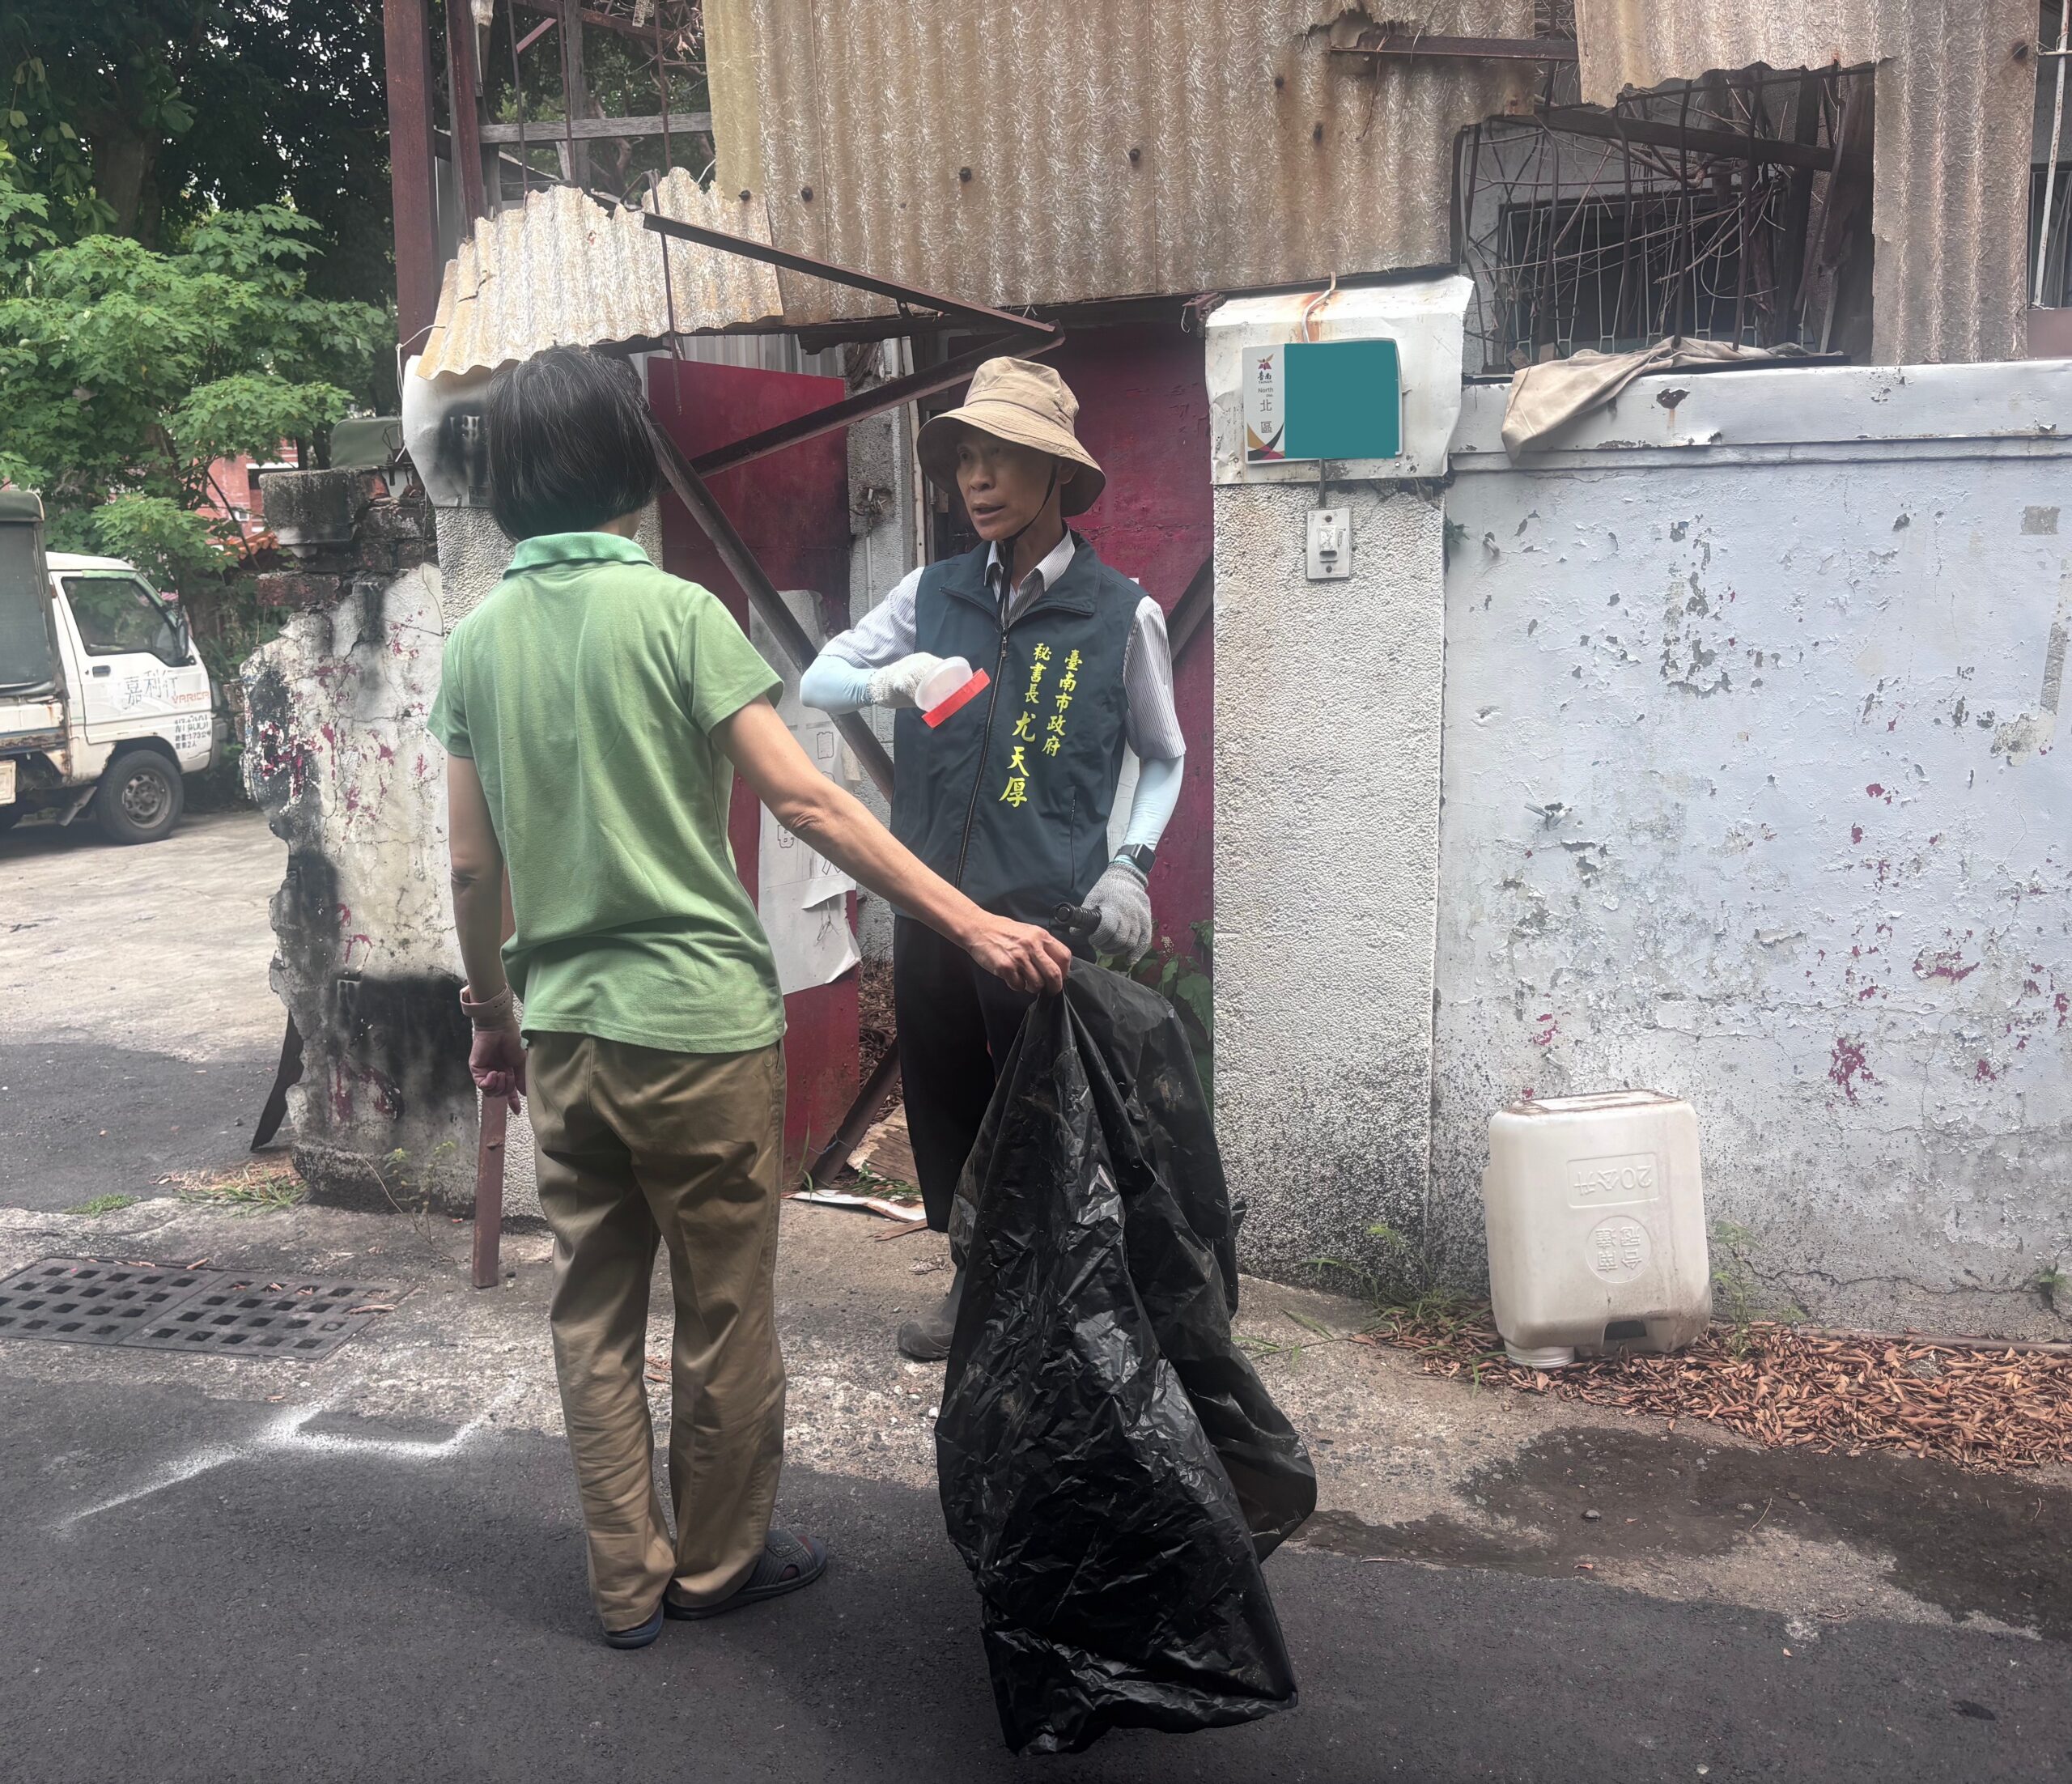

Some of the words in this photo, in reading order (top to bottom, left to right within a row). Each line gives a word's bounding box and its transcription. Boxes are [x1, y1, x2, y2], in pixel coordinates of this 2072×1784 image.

[1259, 399, 1272, 433] 北區
[172, 691, 210, 703] VARICA
[1042, 649, 1083, 757] 臺南市政府
[999, 711, 1036, 808] 尤天厚
[1573, 1165, 1652, 1196] 20公升
